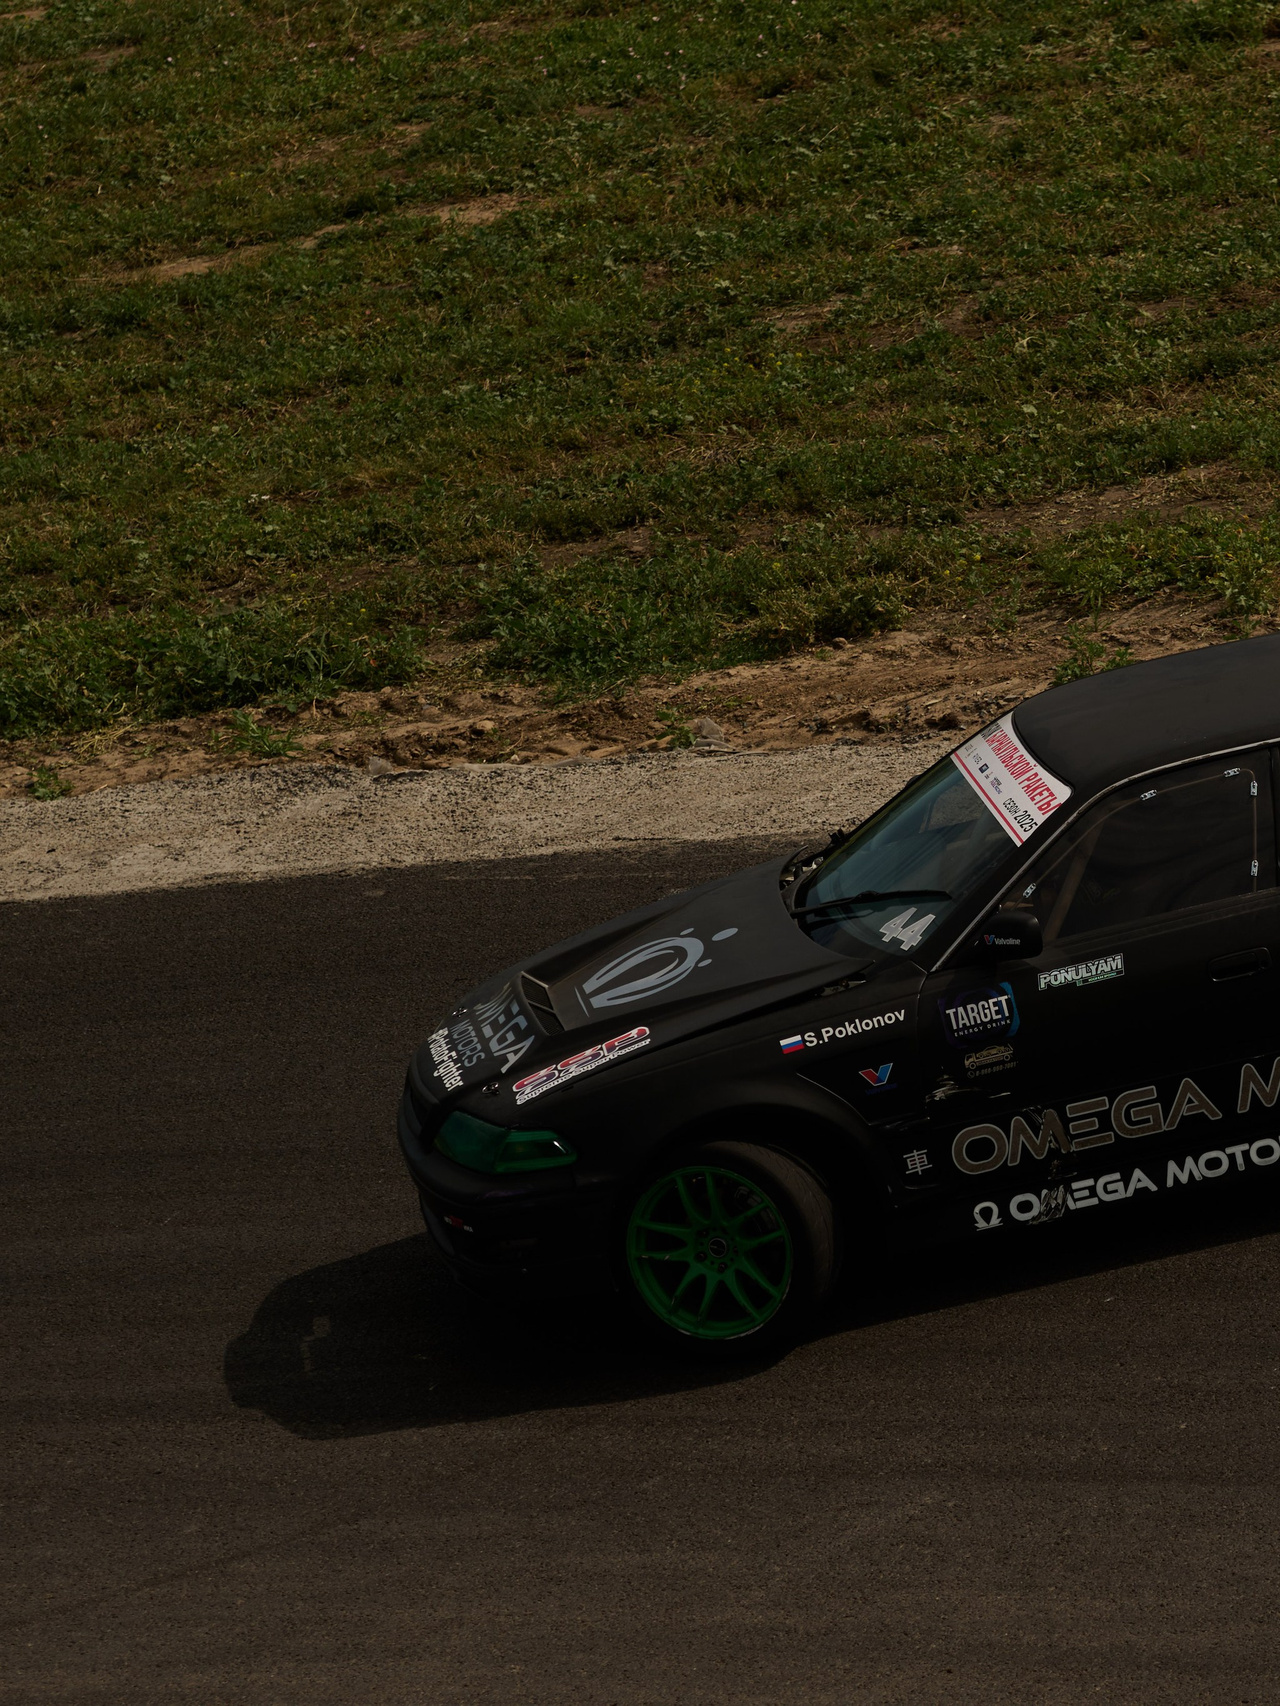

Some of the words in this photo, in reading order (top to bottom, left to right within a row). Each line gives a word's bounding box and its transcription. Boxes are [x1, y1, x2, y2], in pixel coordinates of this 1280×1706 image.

[1018, 772, 1062, 815] РАКЕТЫ
[1002, 797, 1021, 816] СЕЗОН
[1014, 810, 1038, 833] 2025
[879, 907, 936, 951] 44
[1039, 955, 1122, 989] PONULYAM
[803, 1008, 906, 1049] S.Poklonov
[945, 995, 1009, 1031] TARGET
[954, 1026, 983, 1038] ENERGY
[986, 1019, 1011, 1030] DRINK
[449, 1019, 486, 1068] MOTORS
[512, 1026, 650, 1100] SSP
[952, 1077, 1222, 1176] OMEGA
[903, 1150, 933, 1176] 車
[1009, 1167, 1157, 1222] OMEGA
